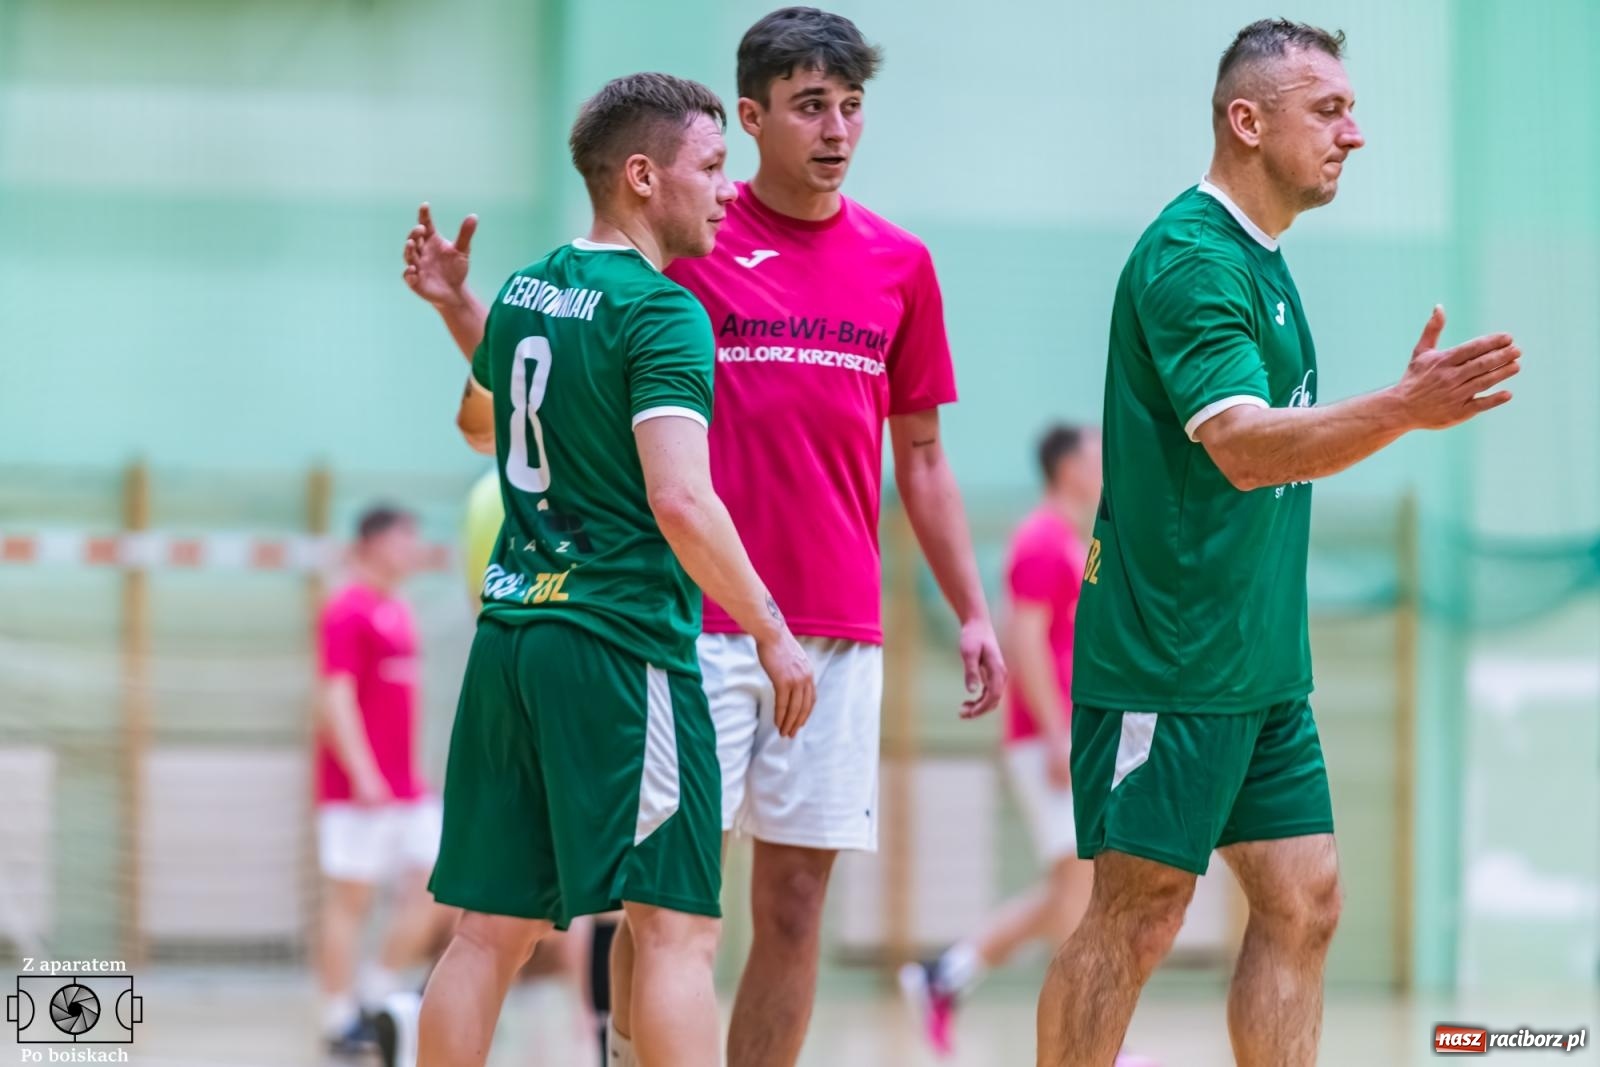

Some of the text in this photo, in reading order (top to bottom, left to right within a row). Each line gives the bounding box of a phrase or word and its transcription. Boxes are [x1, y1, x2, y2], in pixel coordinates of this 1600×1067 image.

[719, 313, 889, 352] AmeWi-Bruk
[717, 346, 887, 377] KOLORZ KRZYSZTOF
[505, 335, 553, 494] 8
